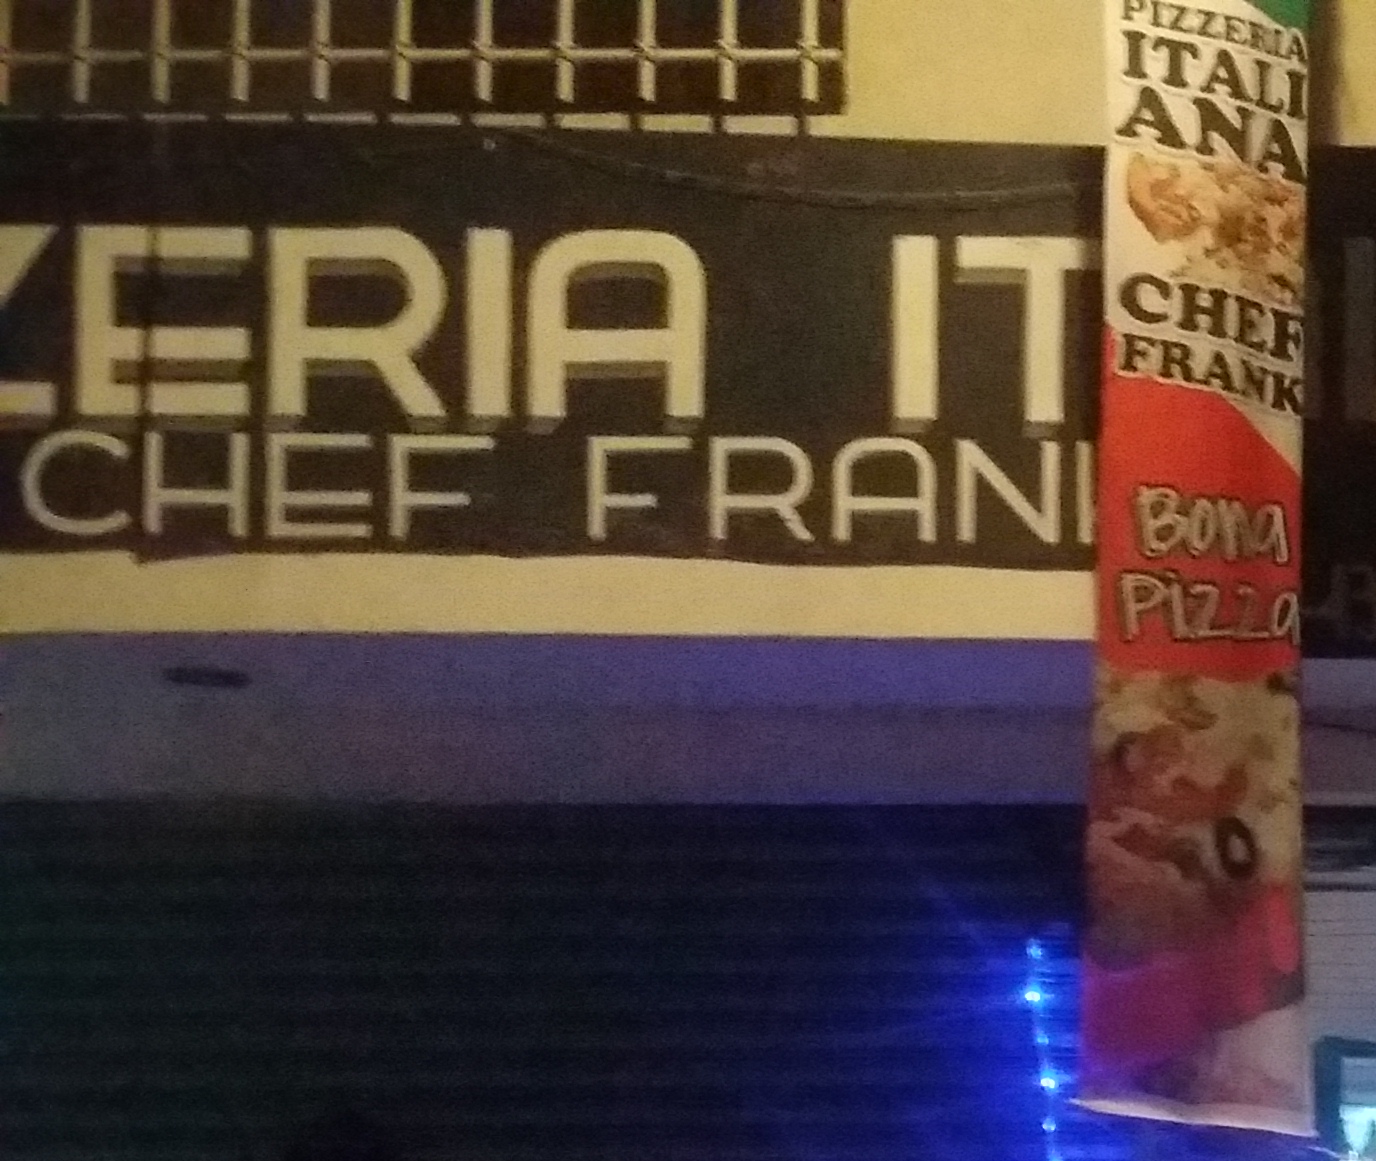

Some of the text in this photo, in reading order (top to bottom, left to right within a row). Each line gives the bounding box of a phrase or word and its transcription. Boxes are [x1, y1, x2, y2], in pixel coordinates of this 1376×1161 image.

[1122, 0, 1306, 63] PIZZERIA
[1122, 29, 1305, 119] ITALI
[1116, 86, 1305, 184] ANA
[1119, 273, 1303, 362] CHEF
[1121, 333, 1302, 414] FRANK
[20, 431, 496, 539] CHEF
